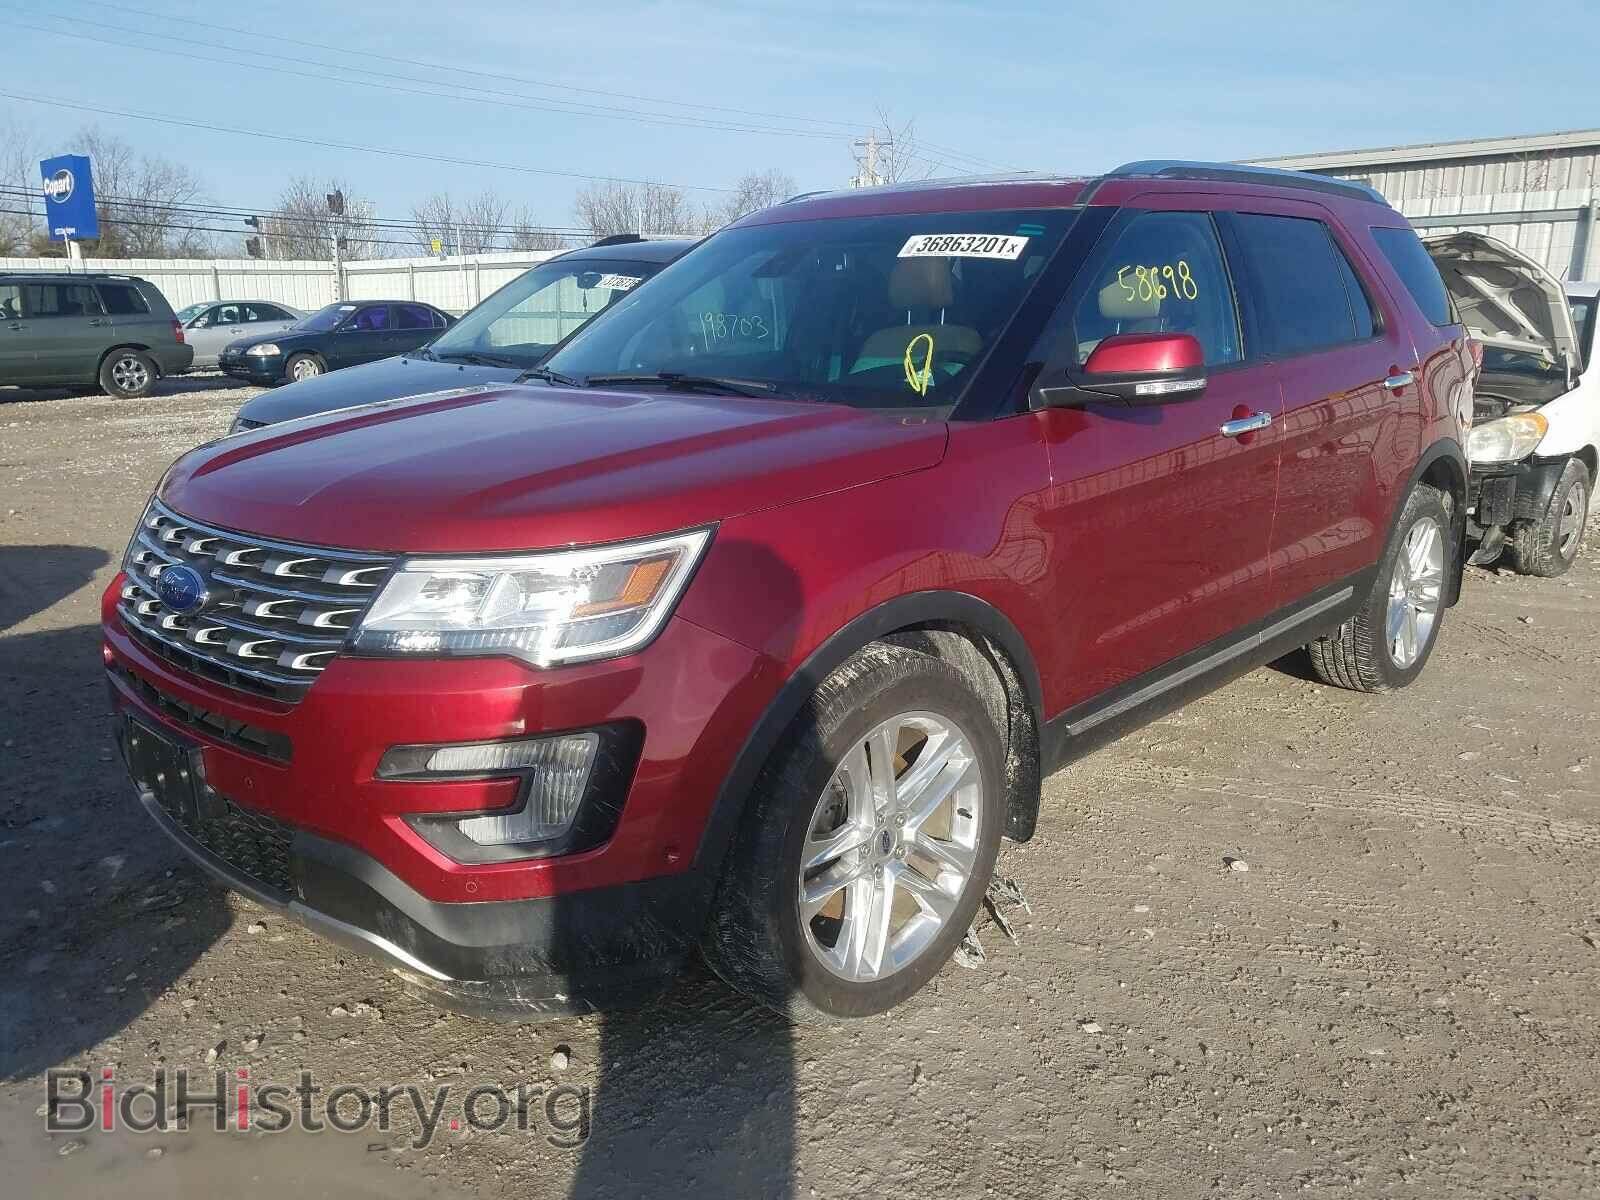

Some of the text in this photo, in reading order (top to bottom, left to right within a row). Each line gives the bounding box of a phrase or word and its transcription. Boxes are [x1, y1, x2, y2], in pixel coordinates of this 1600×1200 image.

[44, 175, 70, 197] Copart
[1117, 260, 1198, 301] 58698
[699, 312, 769, 352] 198703
